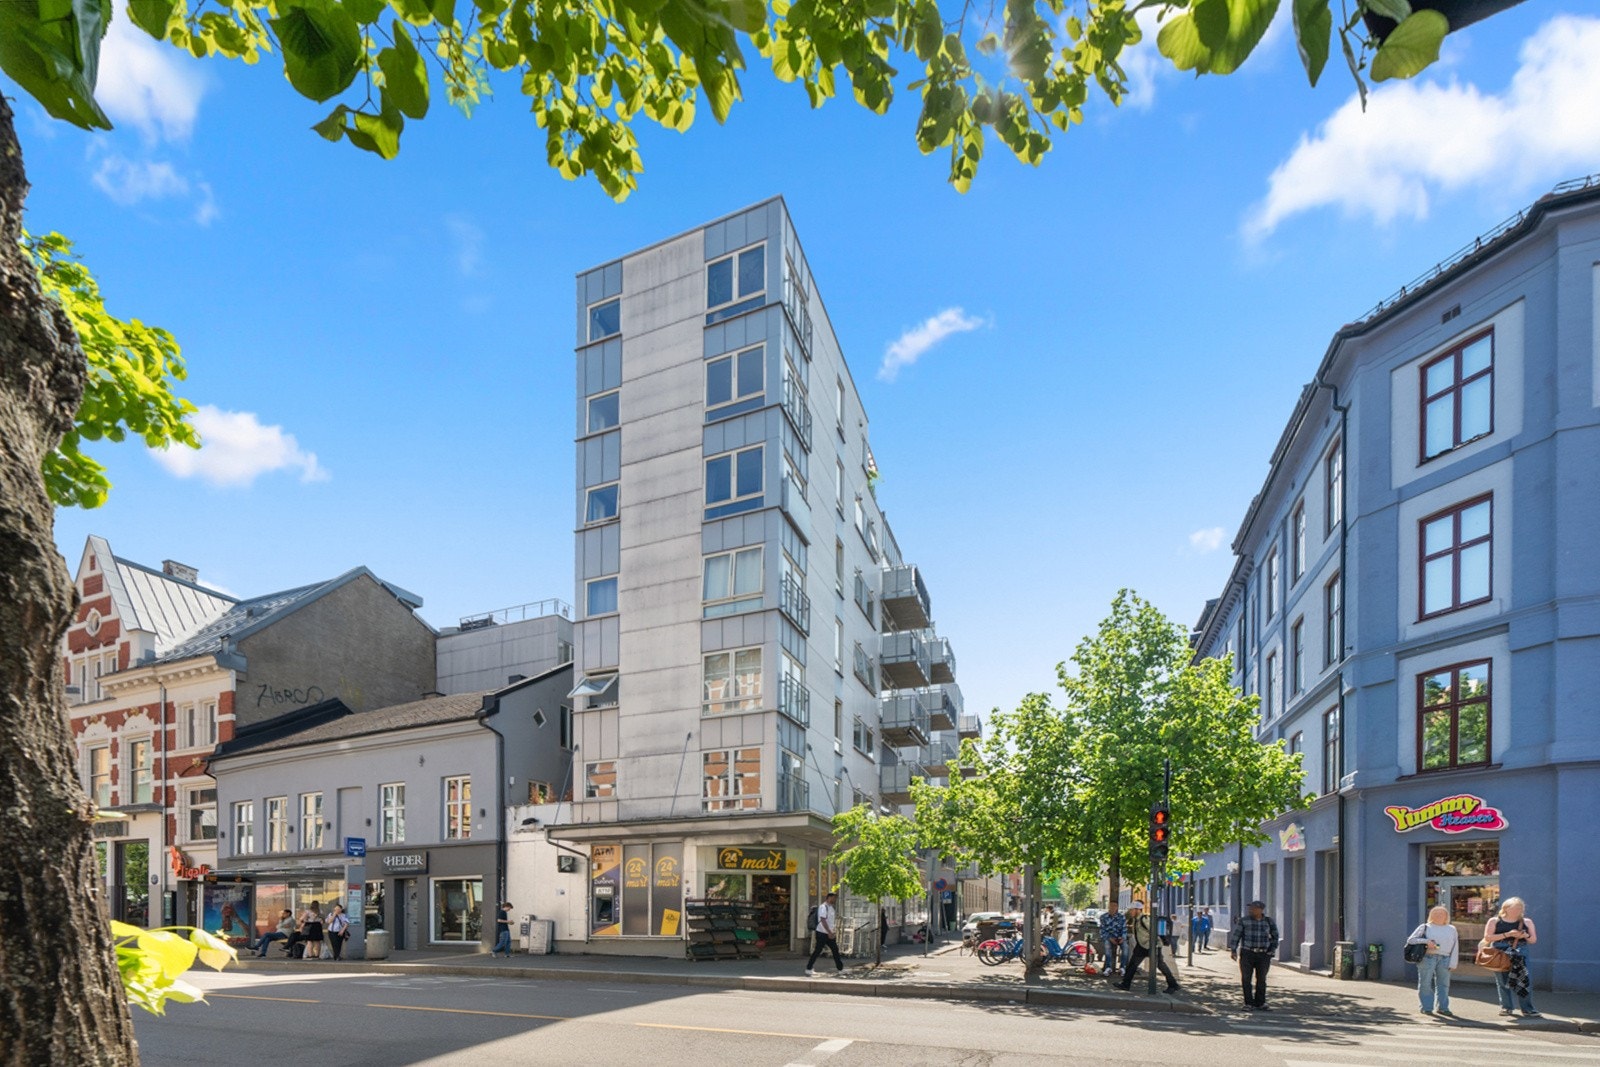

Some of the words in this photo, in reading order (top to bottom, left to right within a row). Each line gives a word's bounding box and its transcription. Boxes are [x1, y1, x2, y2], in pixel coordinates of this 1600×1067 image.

[1387, 796, 1480, 830] Yummy
[1438, 813, 1495, 827] Heaven
[594, 847, 615, 856] ATM
[383, 854, 424, 866] HEDER
[660, 861, 673, 872] 24
[724, 852, 738, 863] 24
[741, 850, 782, 870] mart
[629, 862, 642, 873] 24
[626, 874, 648, 888] mart
[656, 873, 680, 887] mart
